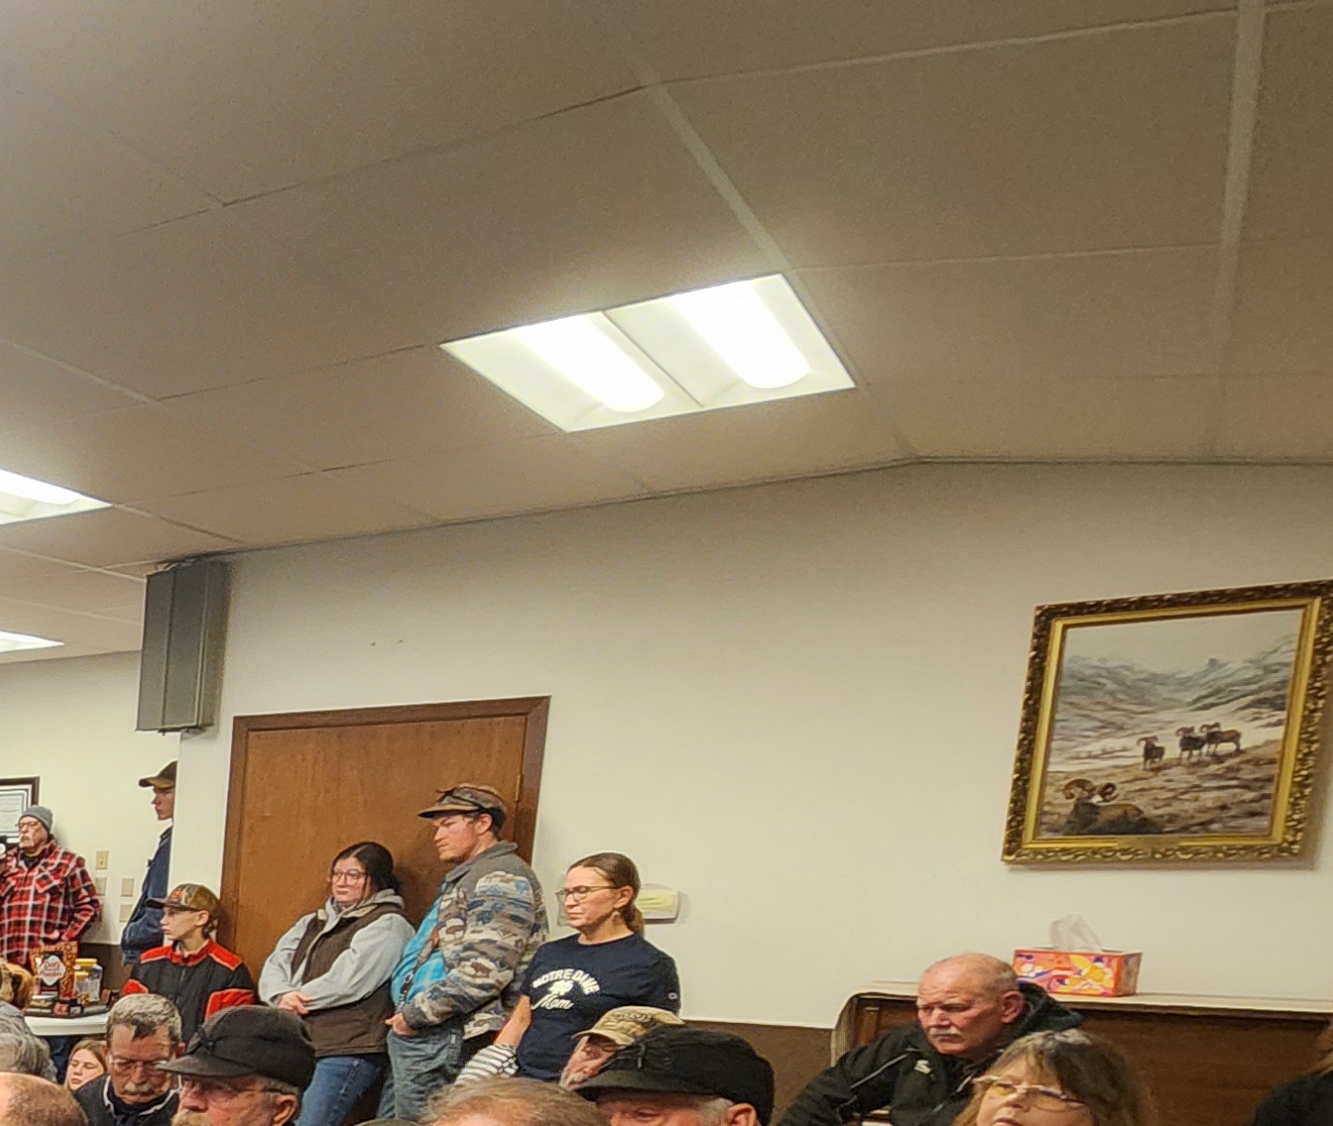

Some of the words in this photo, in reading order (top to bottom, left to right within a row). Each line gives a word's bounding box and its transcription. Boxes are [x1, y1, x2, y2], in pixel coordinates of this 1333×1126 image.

[530, 968, 575, 988] NOTRE
[572, 969, 601, 995] DAME
[530, 994, 575, 1010] Mom
